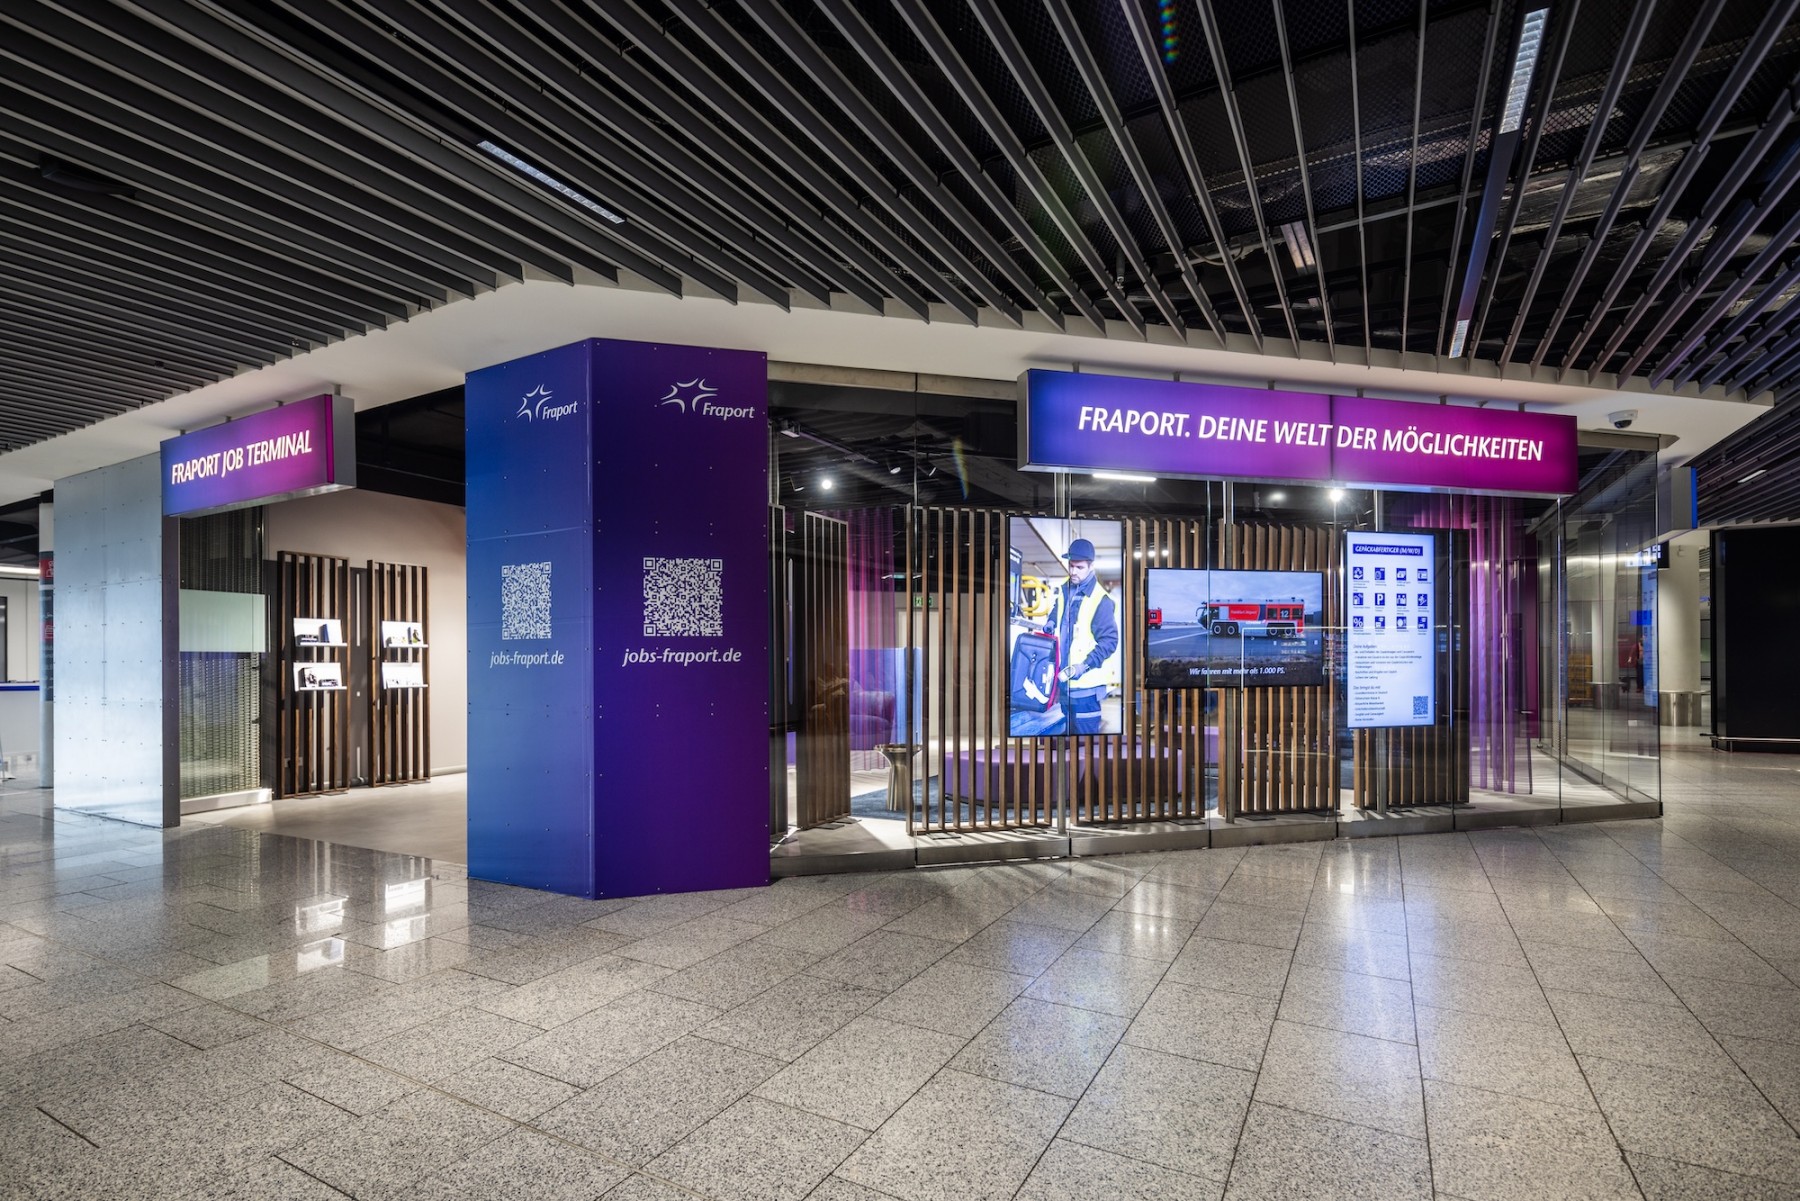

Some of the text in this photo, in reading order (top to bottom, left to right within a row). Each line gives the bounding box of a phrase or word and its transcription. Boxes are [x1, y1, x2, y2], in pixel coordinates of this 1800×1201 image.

[542, 401, 578, 421] Fraport
[703, 402, 755, 420] Fraport
[1079, 407, 1543, 460] FRAPORT. DEINE WELT DER MÖGLICHKEITEN
[172, 430, 312, 485] FRAPORT JOB TERMINAL
[1280, 610, 1289, 618] 12
[490, 650, 565, 668] jobs-fraport.de
[622, 648, 742, 667] jobs-fraport.de
[1249, 667, 1259, 675] als
